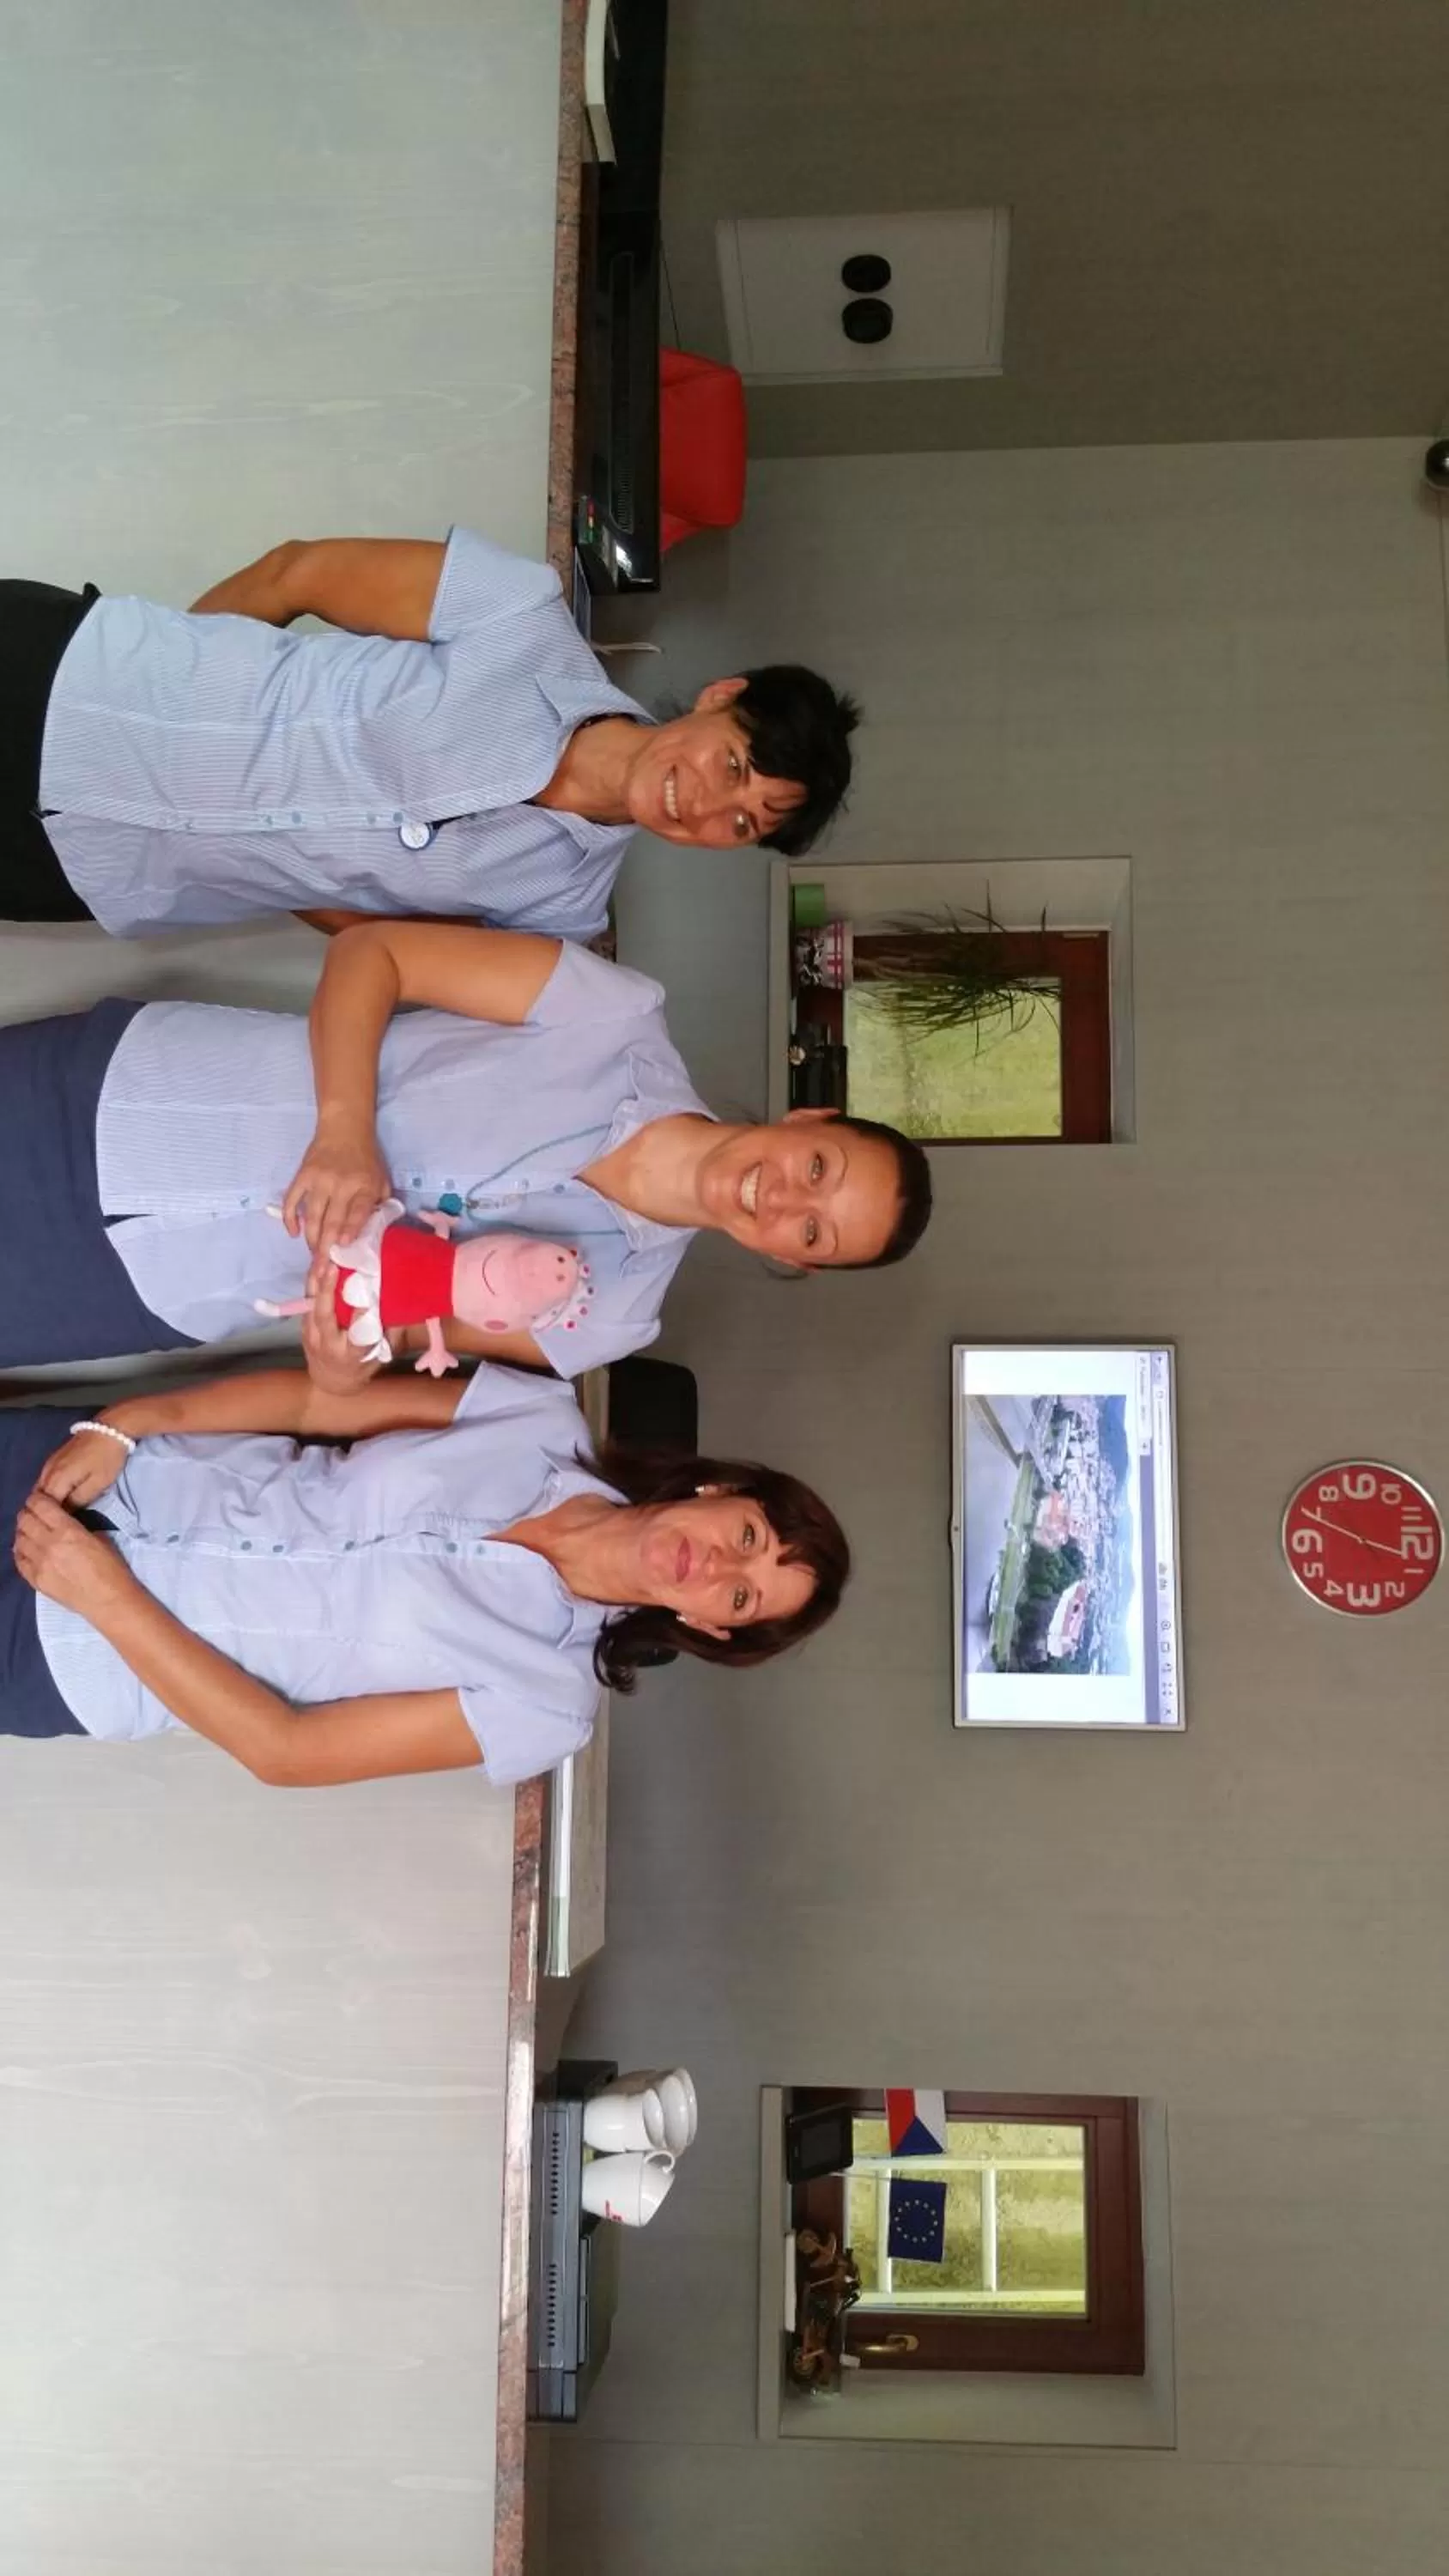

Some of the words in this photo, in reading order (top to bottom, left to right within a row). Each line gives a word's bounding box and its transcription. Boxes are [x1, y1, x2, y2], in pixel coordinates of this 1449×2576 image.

[1319, 1485, 1339, 1503] 8
[1342, 1473, 1377, 1500] 9
[1380, 1484, 1402, 1505] 10
[1300, 1506, 1322, 1522] 7
[1401, 1506, 1422, 1521] 11
[1291, 1528, 1323, 1553] 6
[1400, 1526, 1434, 1559] 12
[1302, 1563, 1324, 1578] 5
[1324, 1580, 1343, 1597] 4
[1346, 1583, 1380, 1607] 3
[1385, 1581, 1404, 1598] 2
